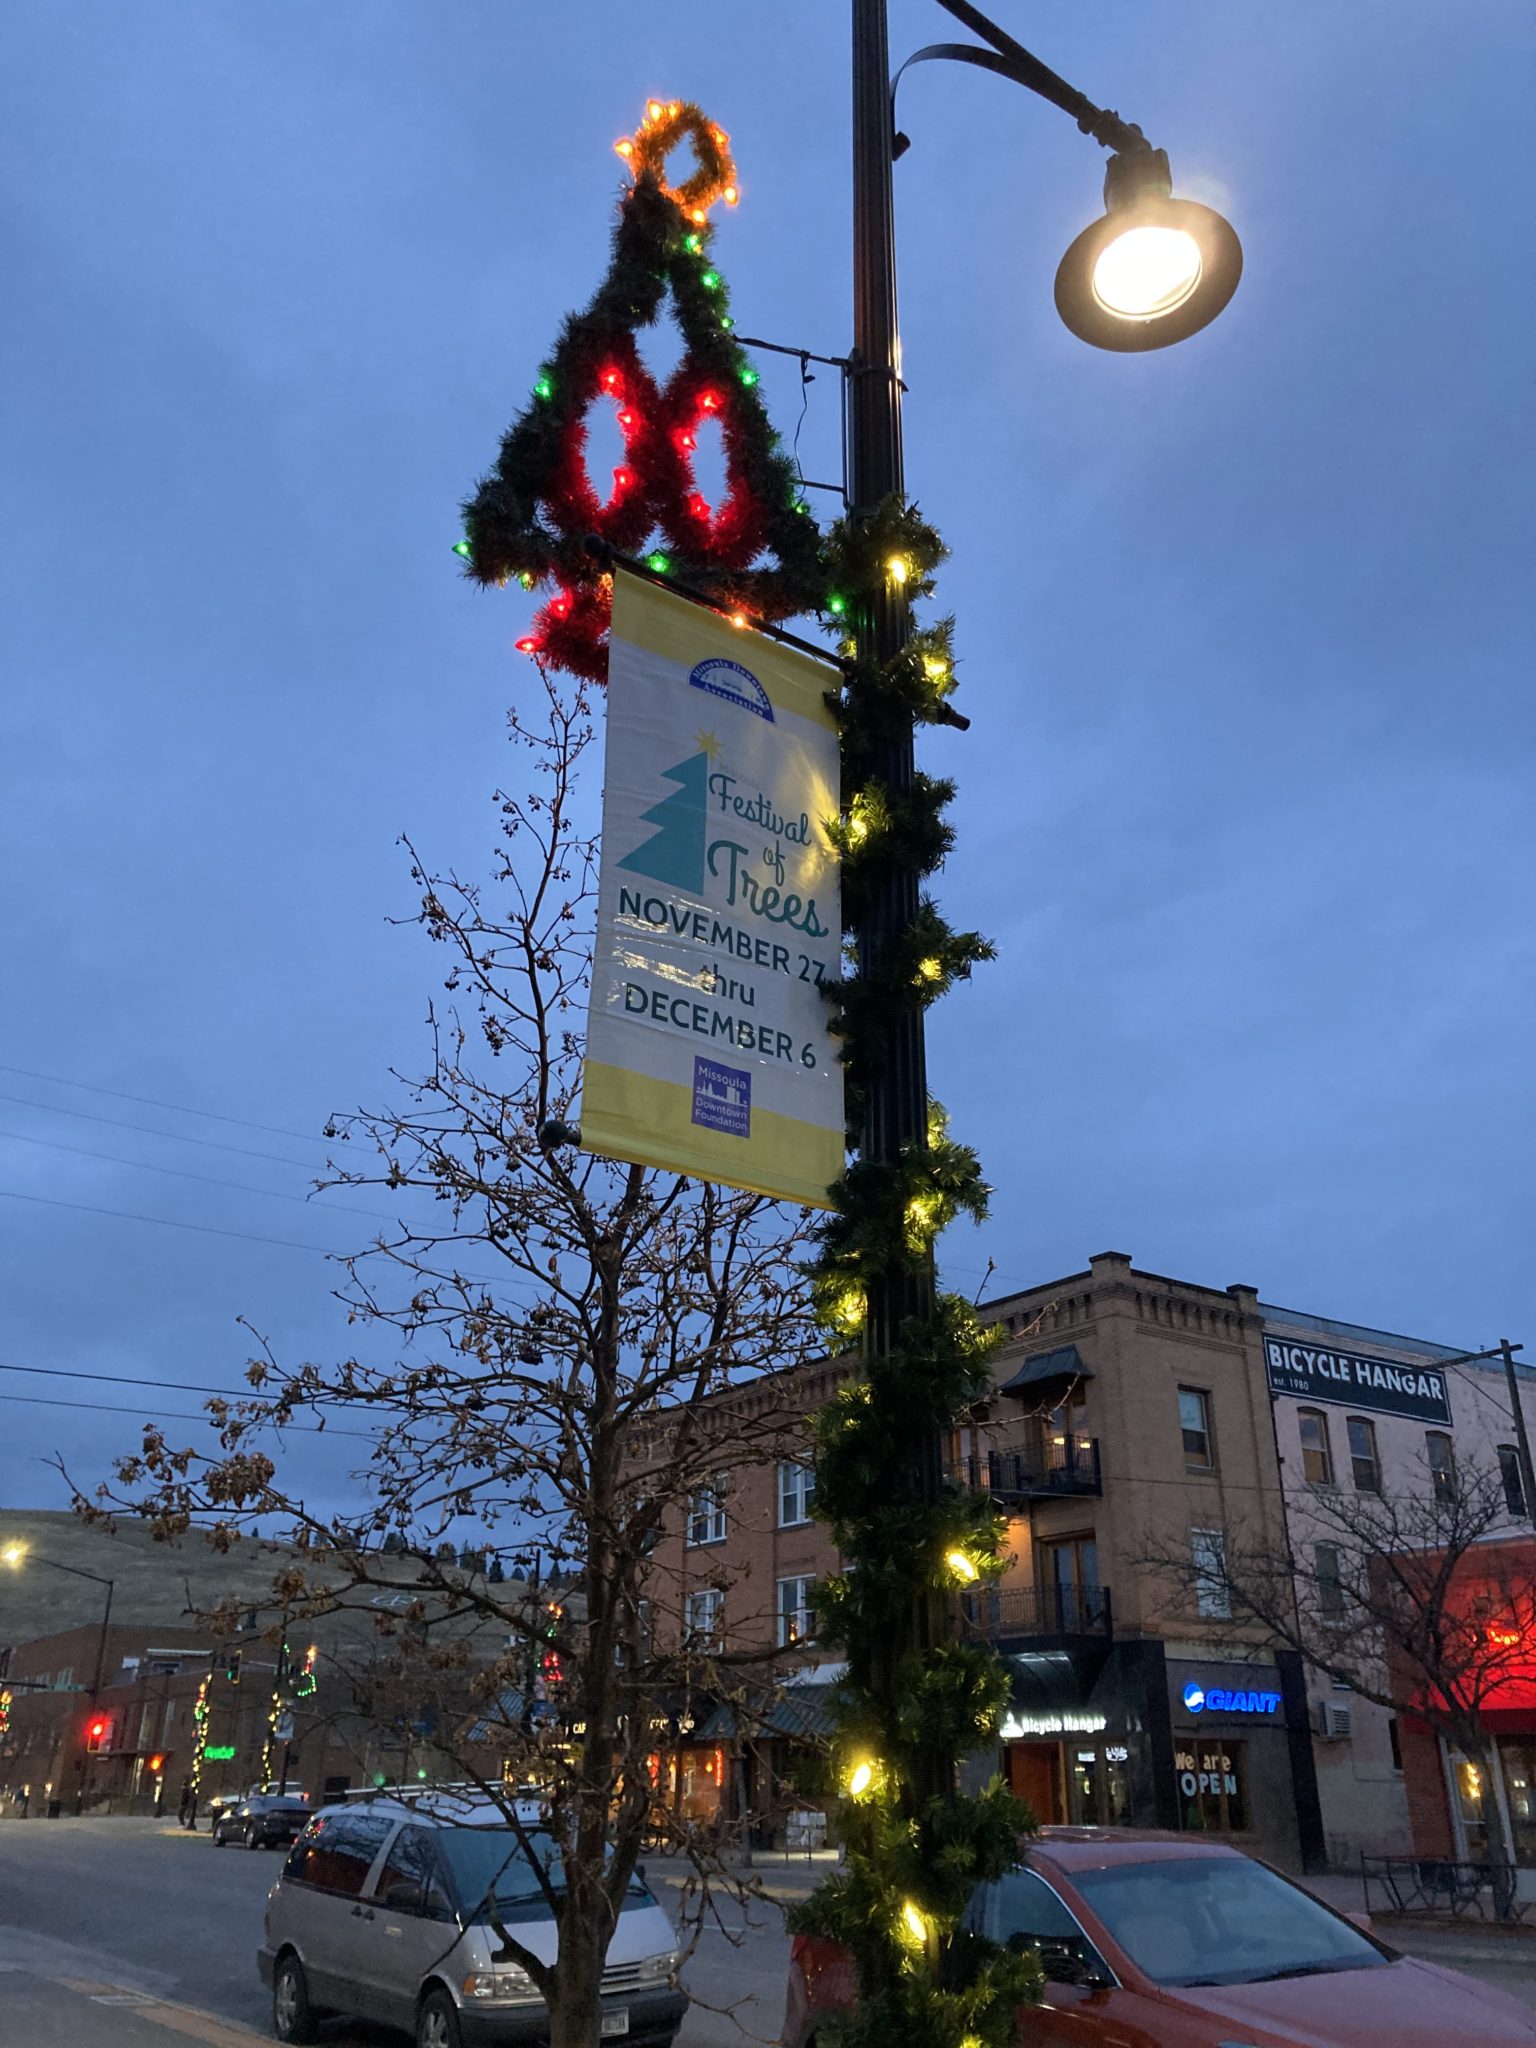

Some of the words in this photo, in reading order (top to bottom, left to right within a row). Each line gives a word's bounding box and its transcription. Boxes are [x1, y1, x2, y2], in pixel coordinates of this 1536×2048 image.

[703, 683, 764, 716] Association
[732, 663, 770, 710] Downtown
[708, 773, 812, 846] Festival
[763, 840, 786, 887] of
[707, 840, 830, 938] Trees
[619, 886, 791, 975] NOVEMBER
[798, 954, 826, 985] 27
[700, 963, 755, 1007] thru
[624, 982, 793, 1063] DECEMBER
[801, 1042, 817, 1069] 6
[698, 1064, 747, 1090] Missoula
[695, 1097, 747, 1120] Downtown
[695, 1108, 748, 1131] Foundation
[1268, 1343, 1351, 1382] BICYCLE
[1355, 1361, 1444, 1400] HANGAR
[1205, 1688, 1281, 1713] GIANT
[1022, 1715, 1062, 1735] Bicycle
[1063, 1714, 1107, 1733] Hangar
[1174, 1752, 1196, 1771] We
[1203, 1754, 1232, 1772] are
[1181, 1772, 1237, 1797] OPEN
